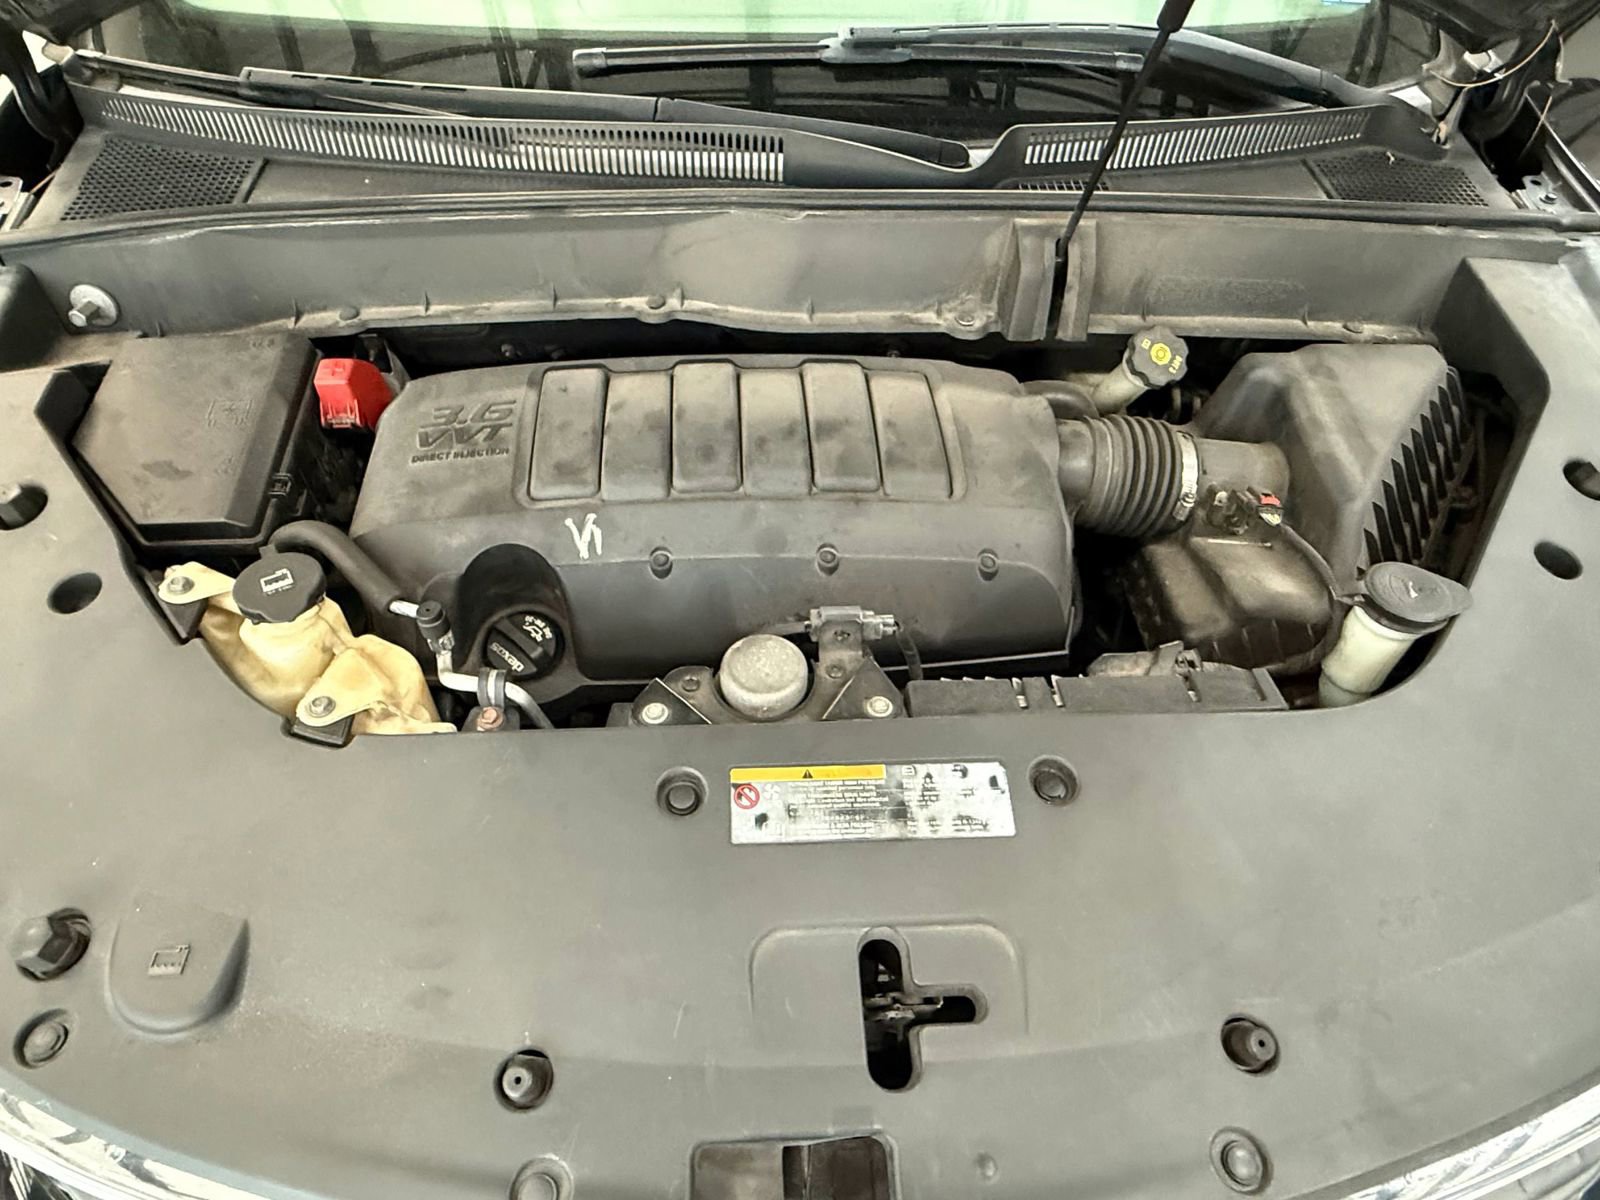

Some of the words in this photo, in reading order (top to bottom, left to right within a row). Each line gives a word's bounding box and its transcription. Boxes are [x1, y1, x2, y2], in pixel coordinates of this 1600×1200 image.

[433, 400, 517, 424] 3.6
[418, 422, 513, 448] VVT
[411, 451, 450, 464] DIRECT
[453, 448, 510, 459] INJECTION
[489, 641, 525, 672] dexos
